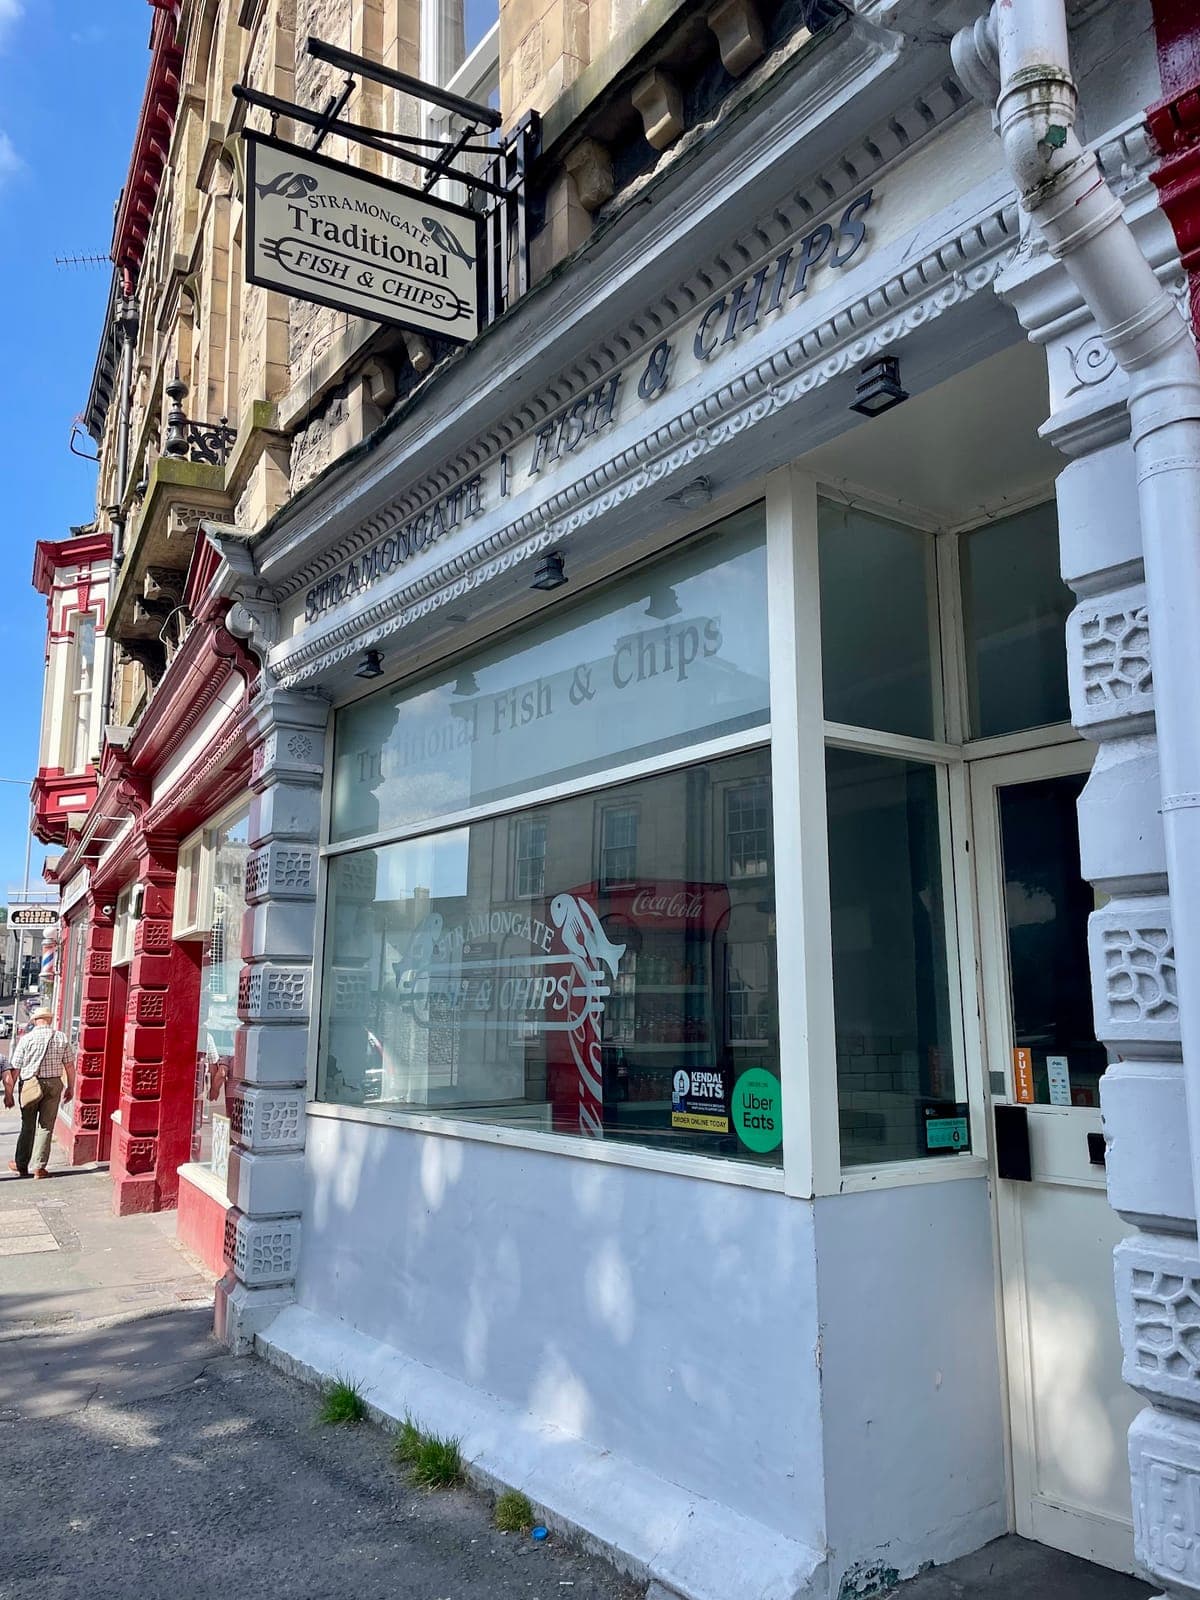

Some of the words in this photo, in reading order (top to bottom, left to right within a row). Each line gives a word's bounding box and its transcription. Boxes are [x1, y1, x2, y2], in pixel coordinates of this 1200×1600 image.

[287, 203, 450, 279] Traditional
[307, 194, 442, 247] STRAMONGATE
[295, 250, 351, 281] FISH
[356, 270, 375, 288] &
[381, 278, 447, 310] CHIPS
[304, 473, 484, 623] STRAMONGATE
[527, 371, 622, 478] FISH
[637, 339, 673, 402] &
[693, 188, 874, 361] CHIPS
[492, 678, 553, 737] Fish
[568, 664, 597, 706] &
[612, 617, 723, 690] Chips
[438, 911, 555, 961] STRAMONGATE
[499, 975, 572, 1011] CHIPS
[691, 1071, 723, 1083] KENDAL
[1017, 1051, 1028, 1087] PULL
[691, 1082, 725, 1100] EATS
[742, 1092, 774, 1111] Uber
[743, 1111, 775, 1131] Eats
